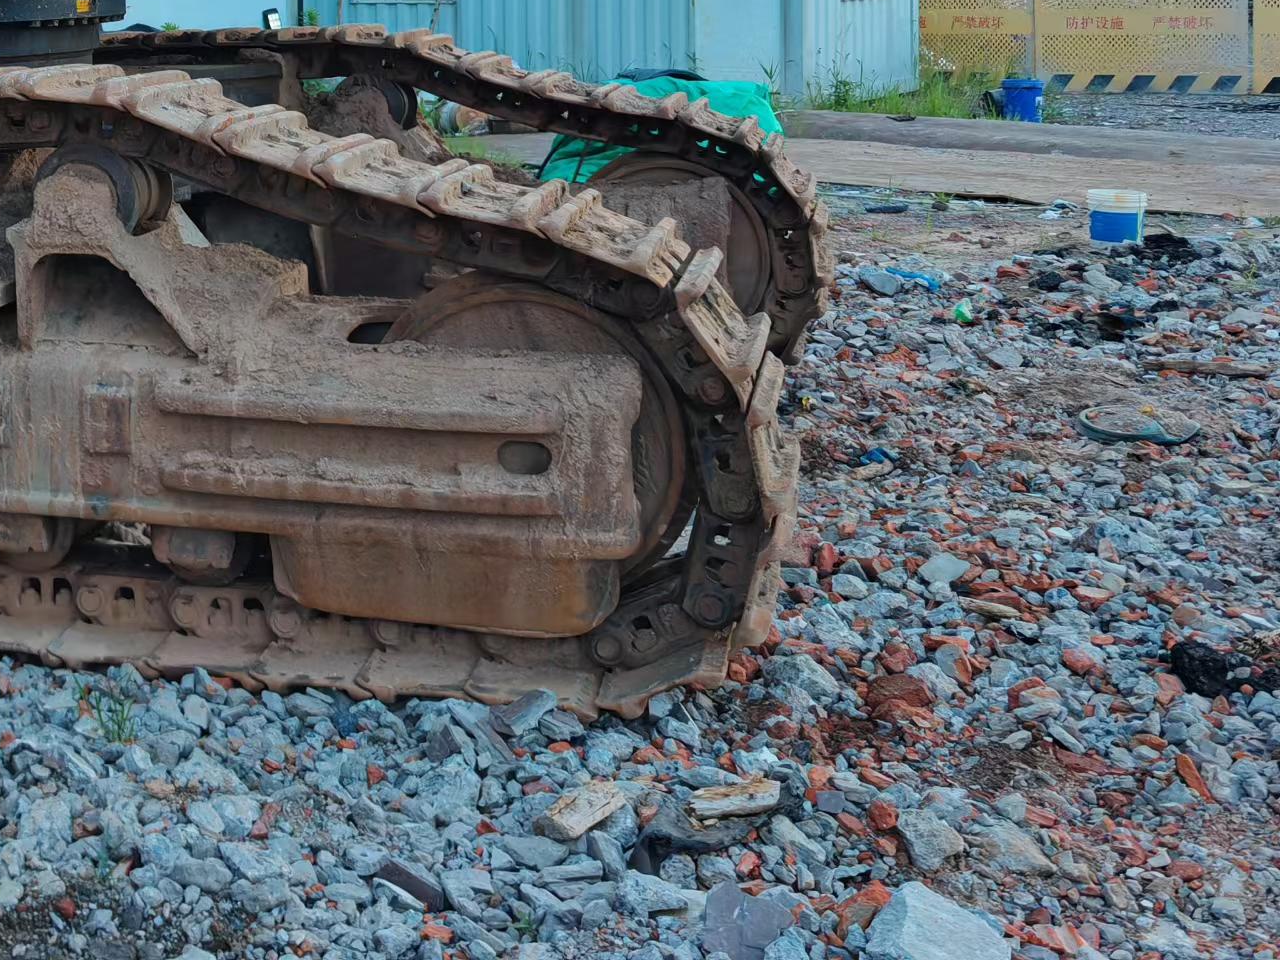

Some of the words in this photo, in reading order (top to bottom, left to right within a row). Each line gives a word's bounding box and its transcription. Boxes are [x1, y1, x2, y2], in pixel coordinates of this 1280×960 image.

[951, 15, 1004, 30] 严禁破坏
[1066, 15, 1124, 30] 防护设施
[1152, 16, 1214, 30] 严禁破坏
